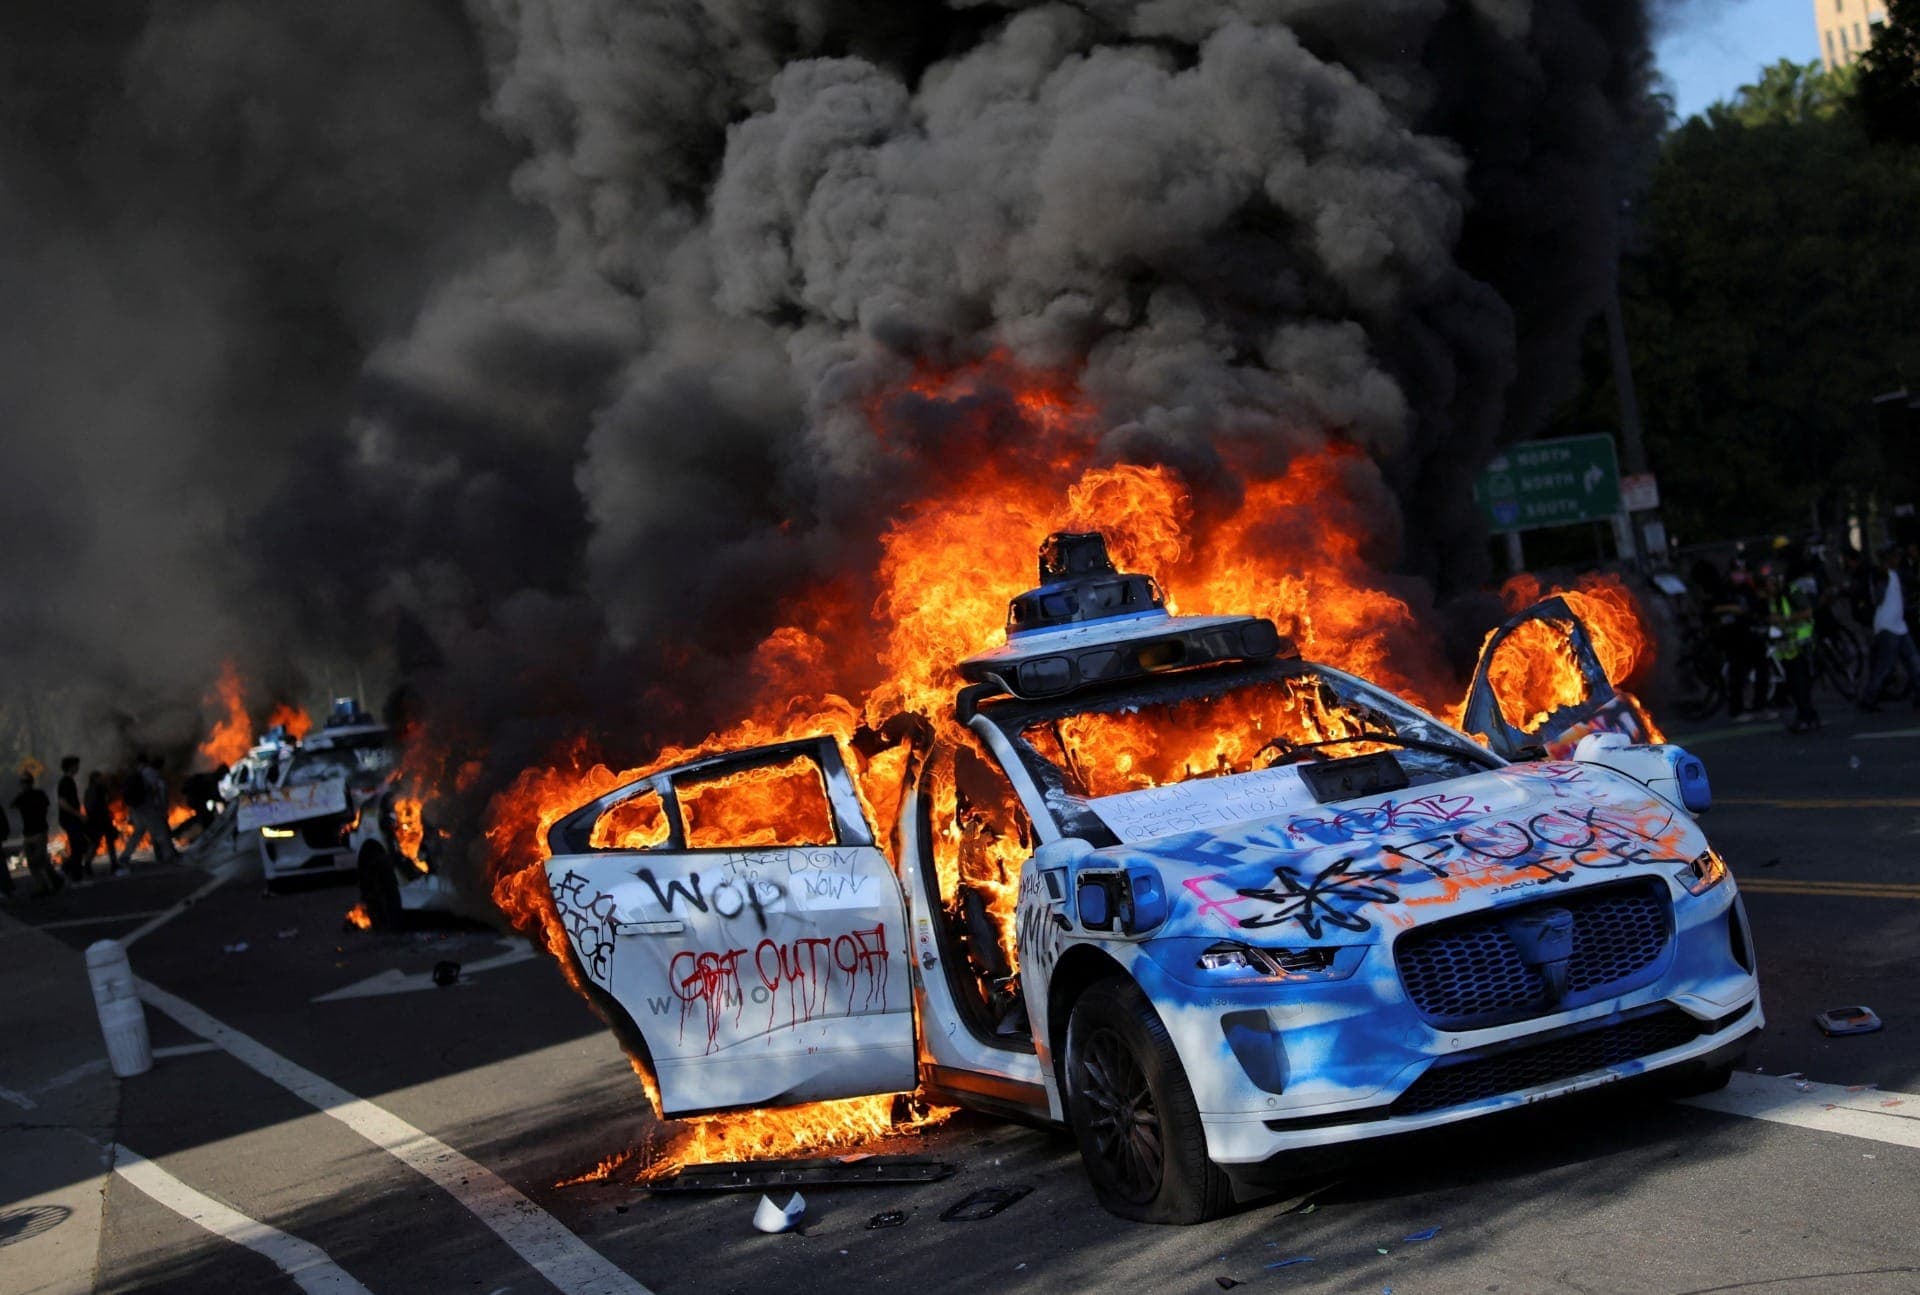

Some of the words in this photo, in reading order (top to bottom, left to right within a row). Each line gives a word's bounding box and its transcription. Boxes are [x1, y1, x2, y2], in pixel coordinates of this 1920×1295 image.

[1381, 807, 1664, 877] FUCK
[723, 848, 860, 887] FREEDOM
[1514, 842, 1688, 883] ICE
[1489, 877, 1548, 896] JAGU
[646, 985, 770, 1016] WMO
